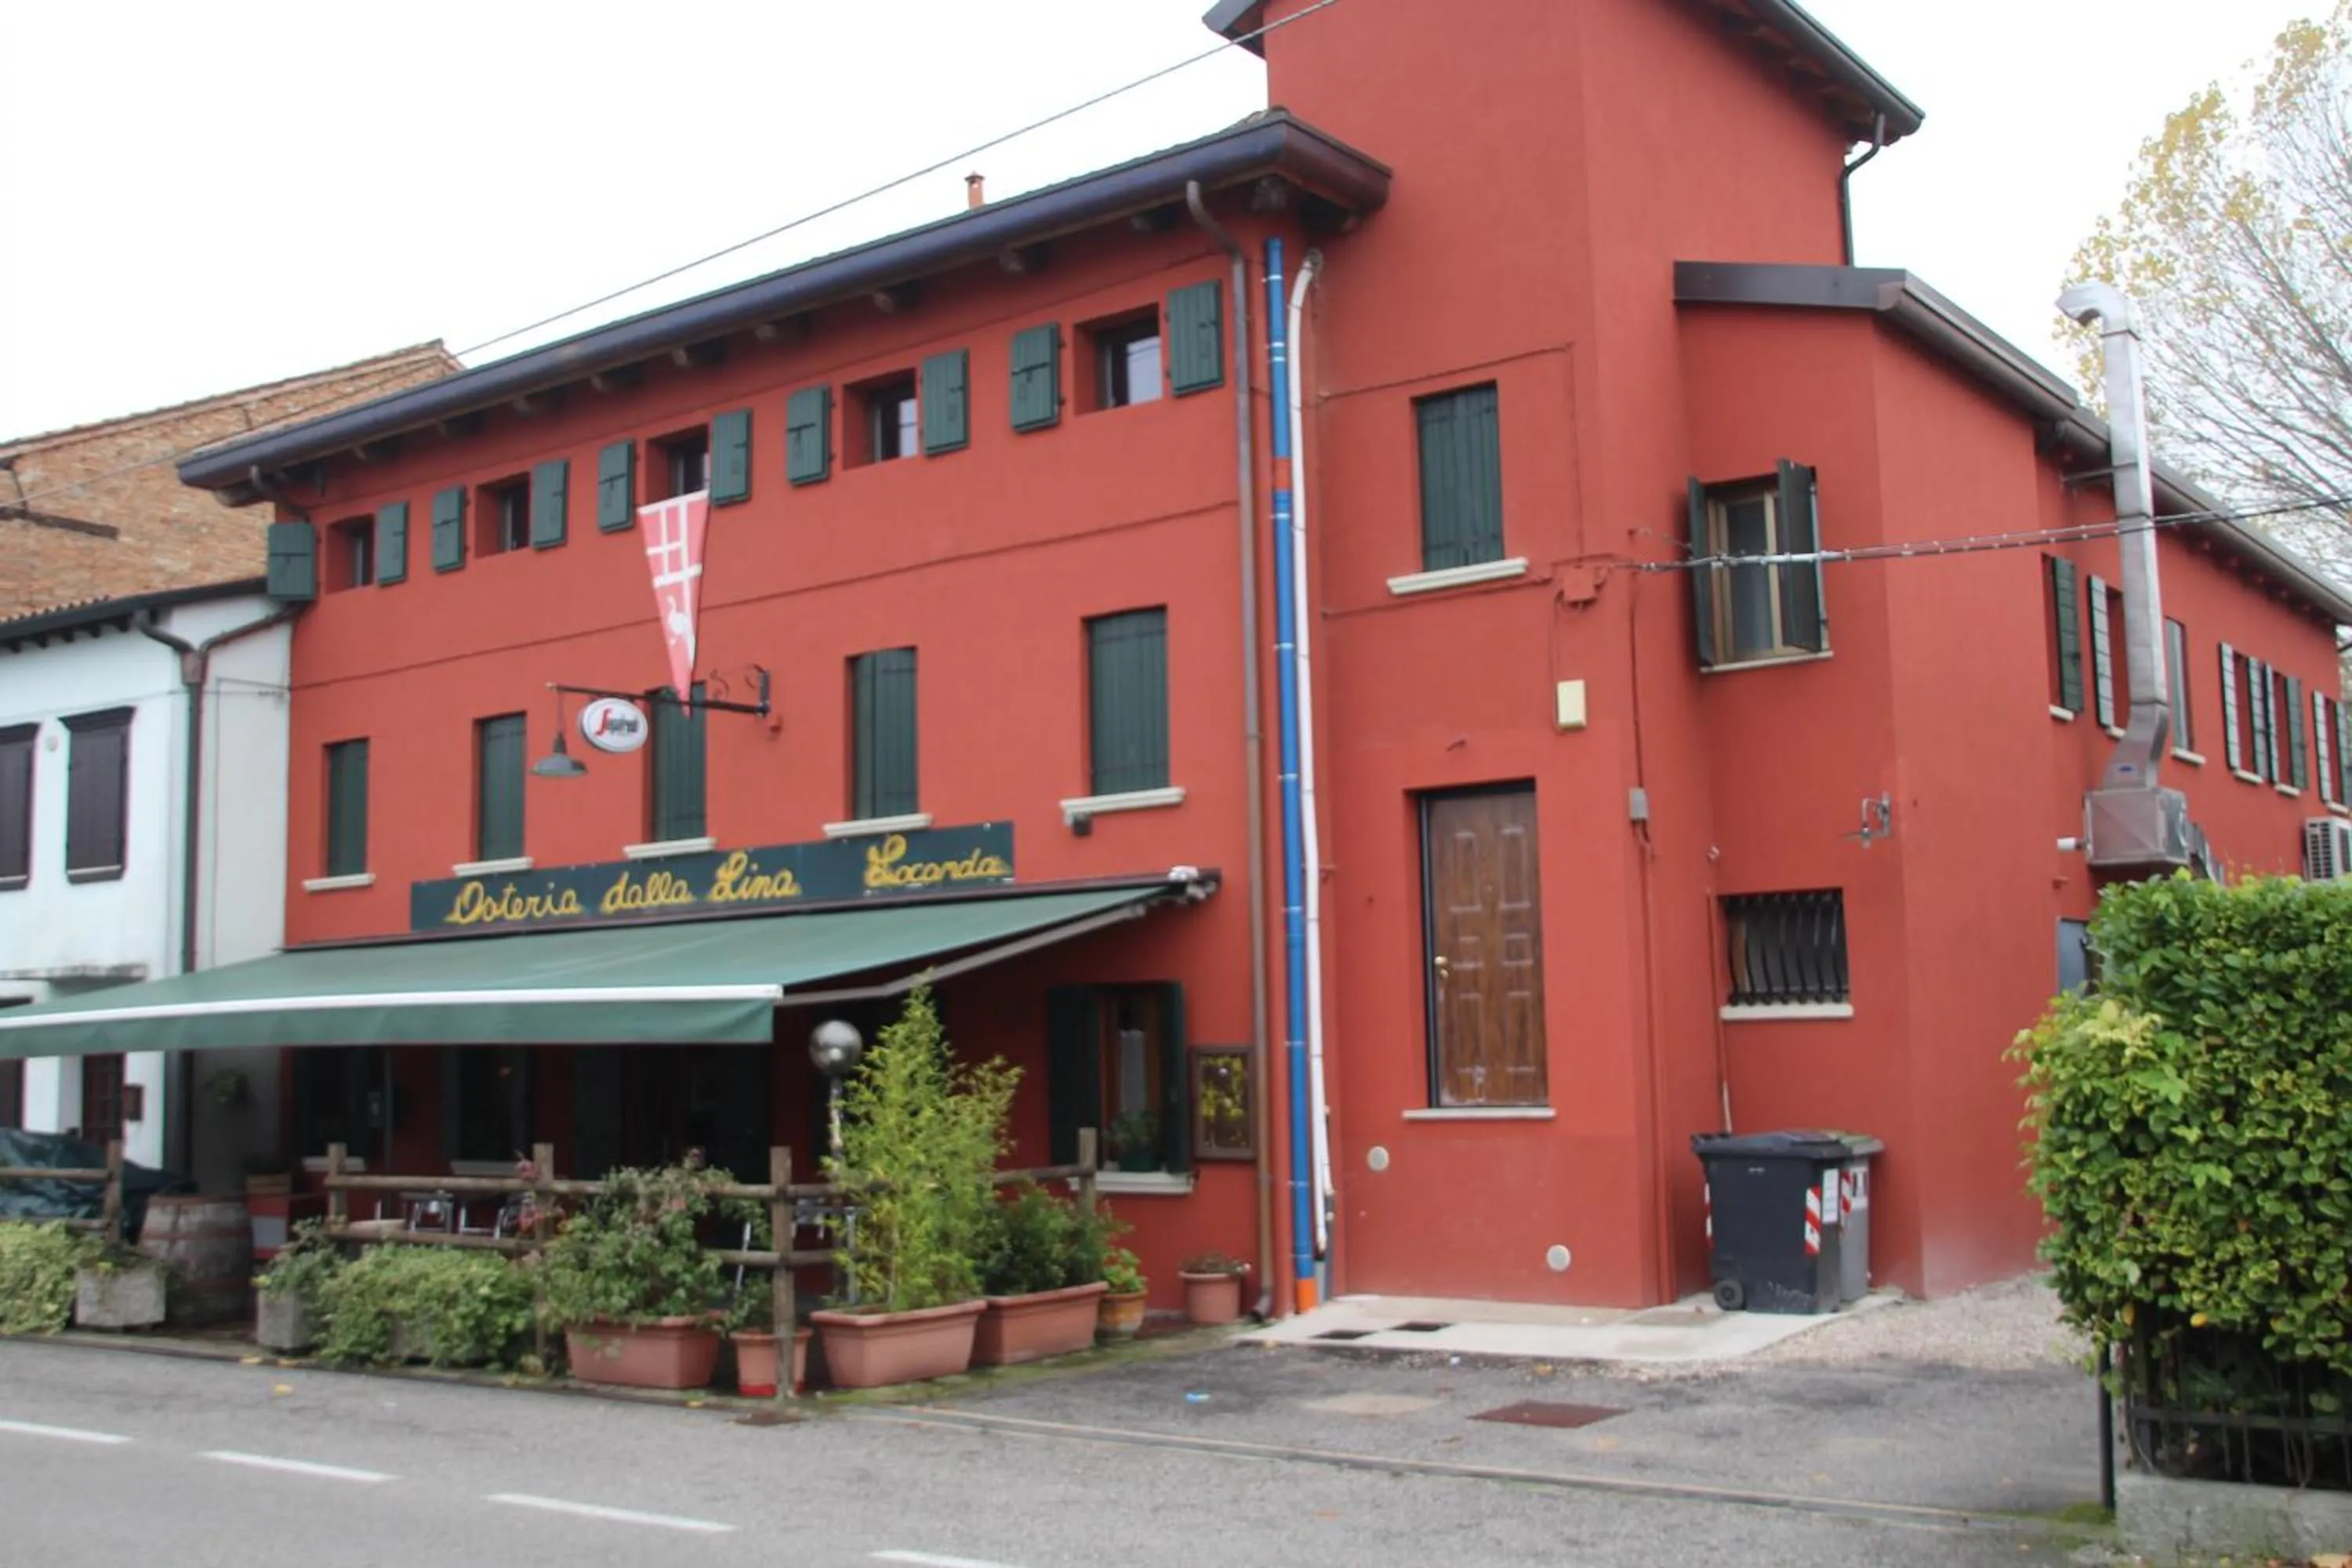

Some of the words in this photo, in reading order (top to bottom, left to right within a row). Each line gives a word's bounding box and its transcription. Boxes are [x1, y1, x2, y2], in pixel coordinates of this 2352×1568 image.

[444, 881, 583, 924] Osteria
[599, 871, 694, 915] dalla
[707, 849, 802, 902] Lina
[865, 833, 1012, 887] Locanda
